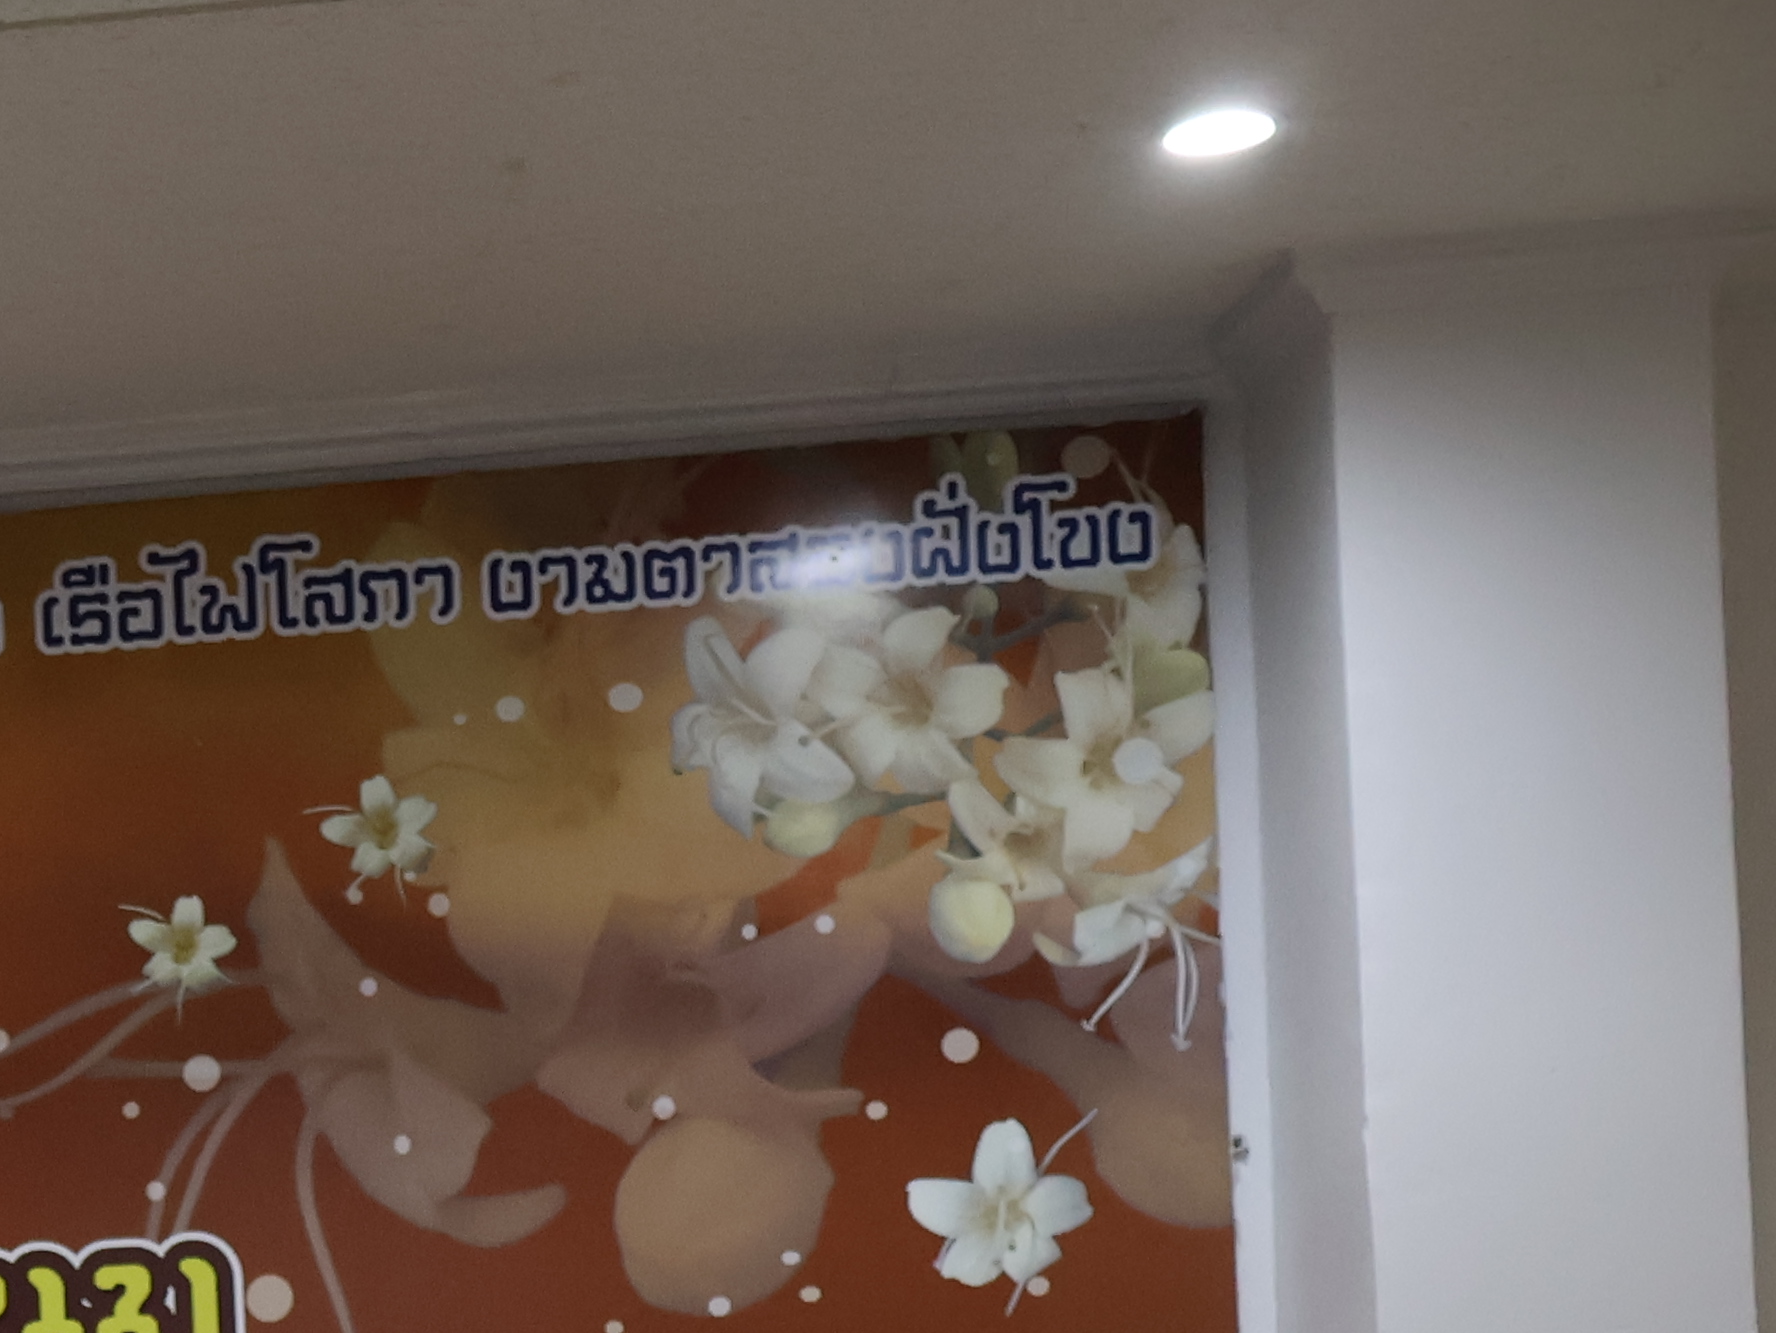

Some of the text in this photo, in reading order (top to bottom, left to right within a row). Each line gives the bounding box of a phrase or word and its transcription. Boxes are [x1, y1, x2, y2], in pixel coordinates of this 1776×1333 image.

[42, 540, 456, 650] เรือไฟโสภา
[489, 479, 1153, 614] งามตาสงฝั่งโขง
